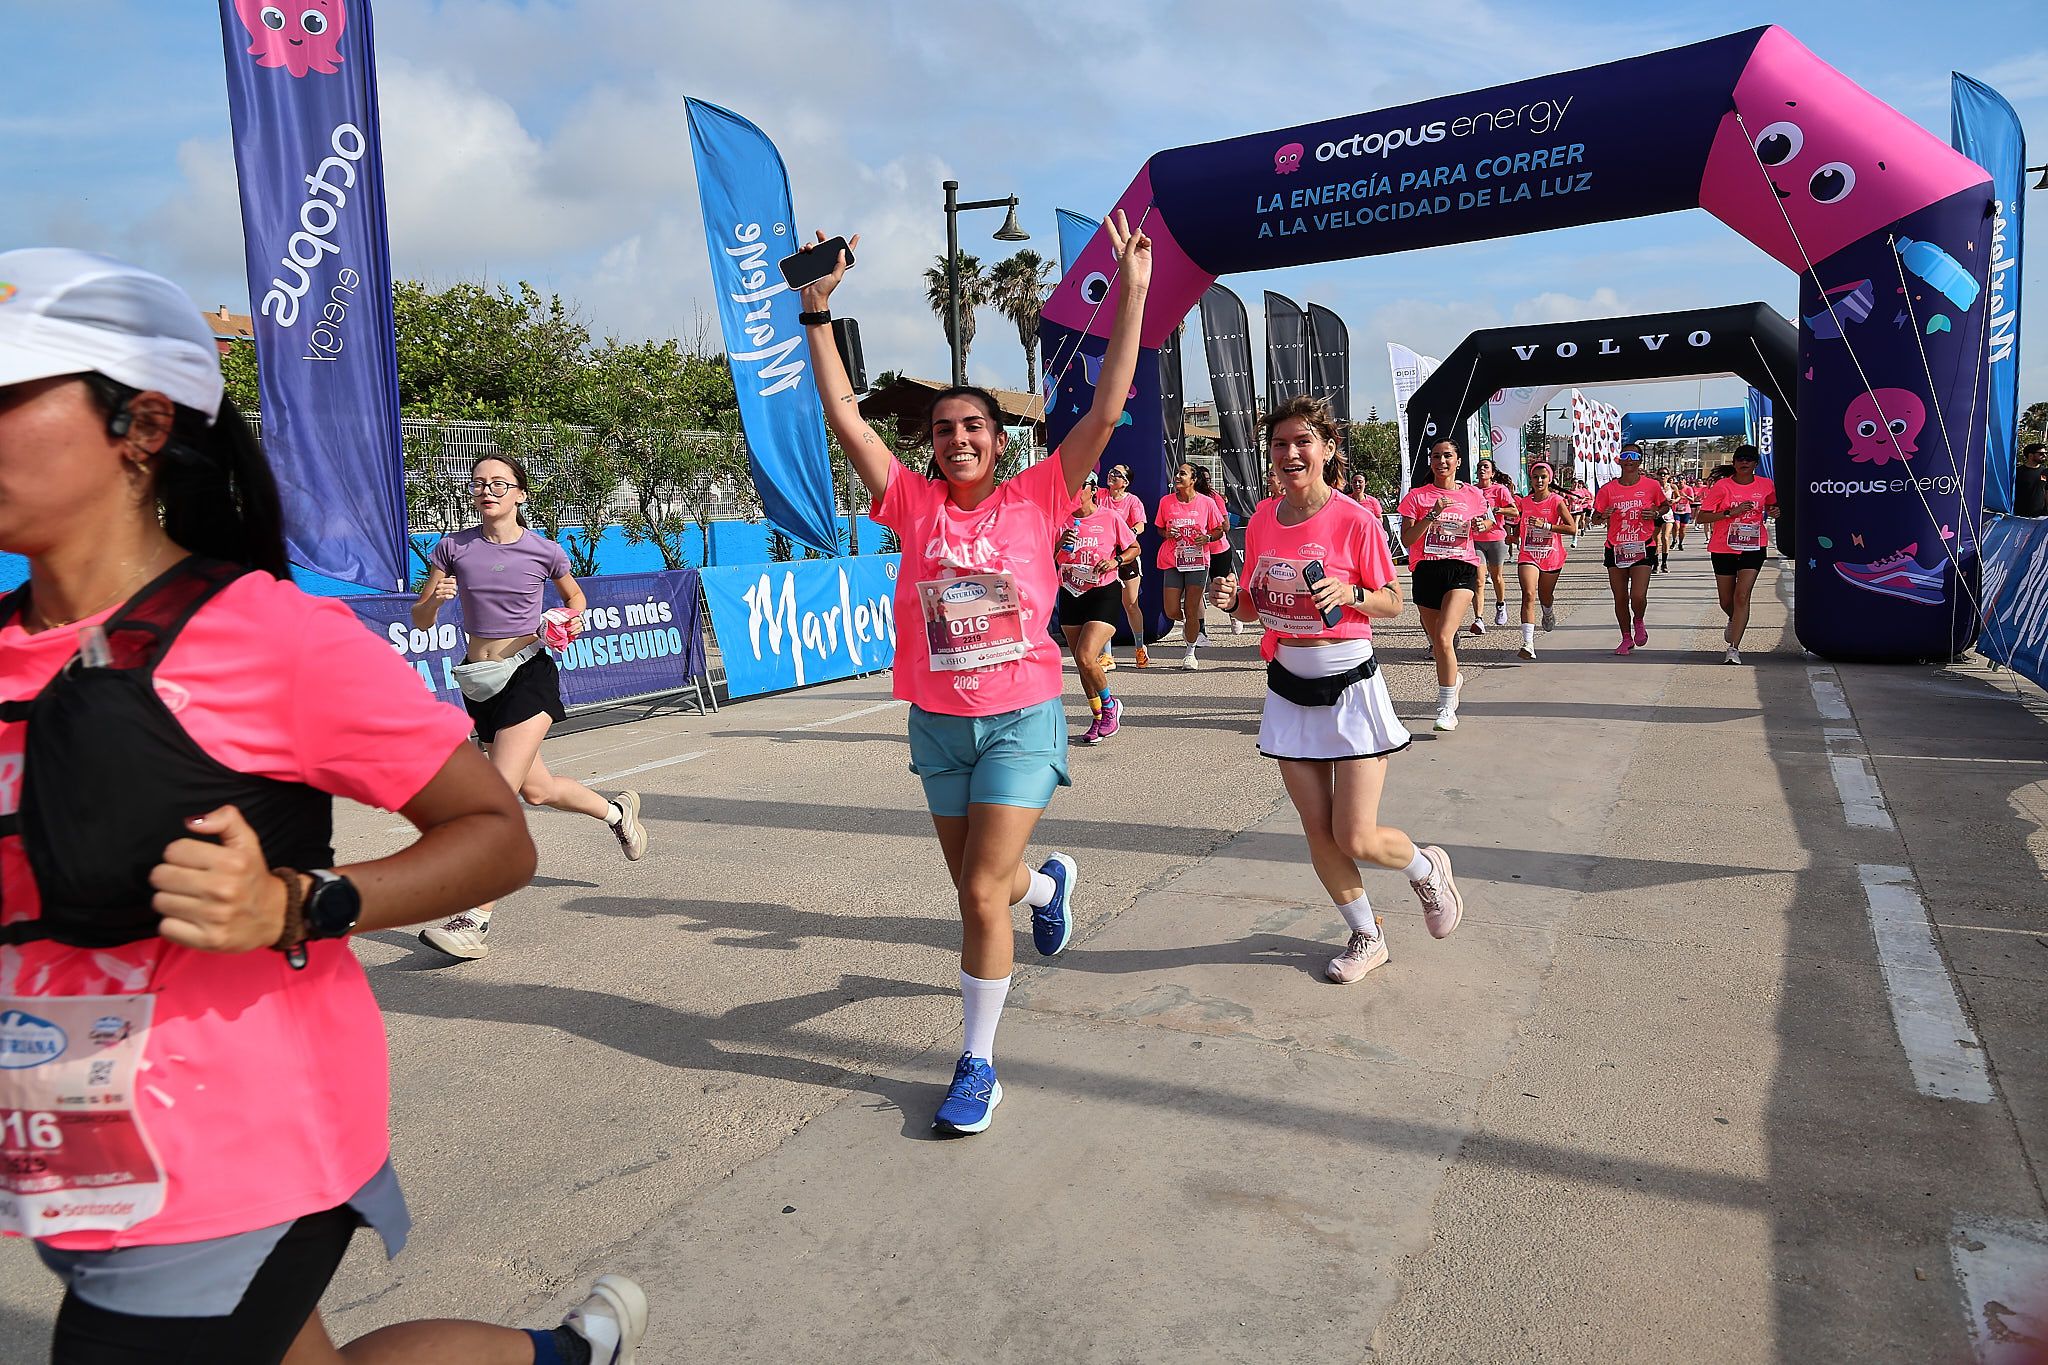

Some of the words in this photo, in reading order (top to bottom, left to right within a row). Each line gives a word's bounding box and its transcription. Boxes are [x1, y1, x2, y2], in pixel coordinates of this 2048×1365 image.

[1315, 121, 1446, 161] octopus
[1452, 96, 1573, 137] energy
[1256, 193, 1284, 213] LA
[1290, 173, 1392, 209] ENERGÍA
[1400, 164, 1467, 191] PARA
[1475, 143, 1585, 178] CORRER
[1257, 222, 1273, 239] A
[1279, 217, 1307, 236] LA
[1313, 196, 1451, 229] VELOCIDAD
[1458, 189, 1491, 210] DE
[1499, 182, 1532, 204] LA
[1540, 172, 1593, 197] LUZ
[1511, 330, 1711, 360] VOLVO
[1664, 412, 1719, 435] Marlene
[1810, 479, 1887, 498] octopus
[1889, 475, 1961, 495] energy
[1630, 510, 1639, 519] DE
[1616, 533, 1639, 541] MUJER
[945, 588, 984, 600] ASTURIANA
[1268, 592, 1295, 606] 016
[388, 622, 456, 655] Solo
[625, 596, 672, 626] más
[742, 565, 896, 686] Marlen
[950, 615, 990, 636] 016
[963, 634, 982, 644] 2219
[953, 675, 979, 690] 2026
[0, 1111, 63, 1149] 16
